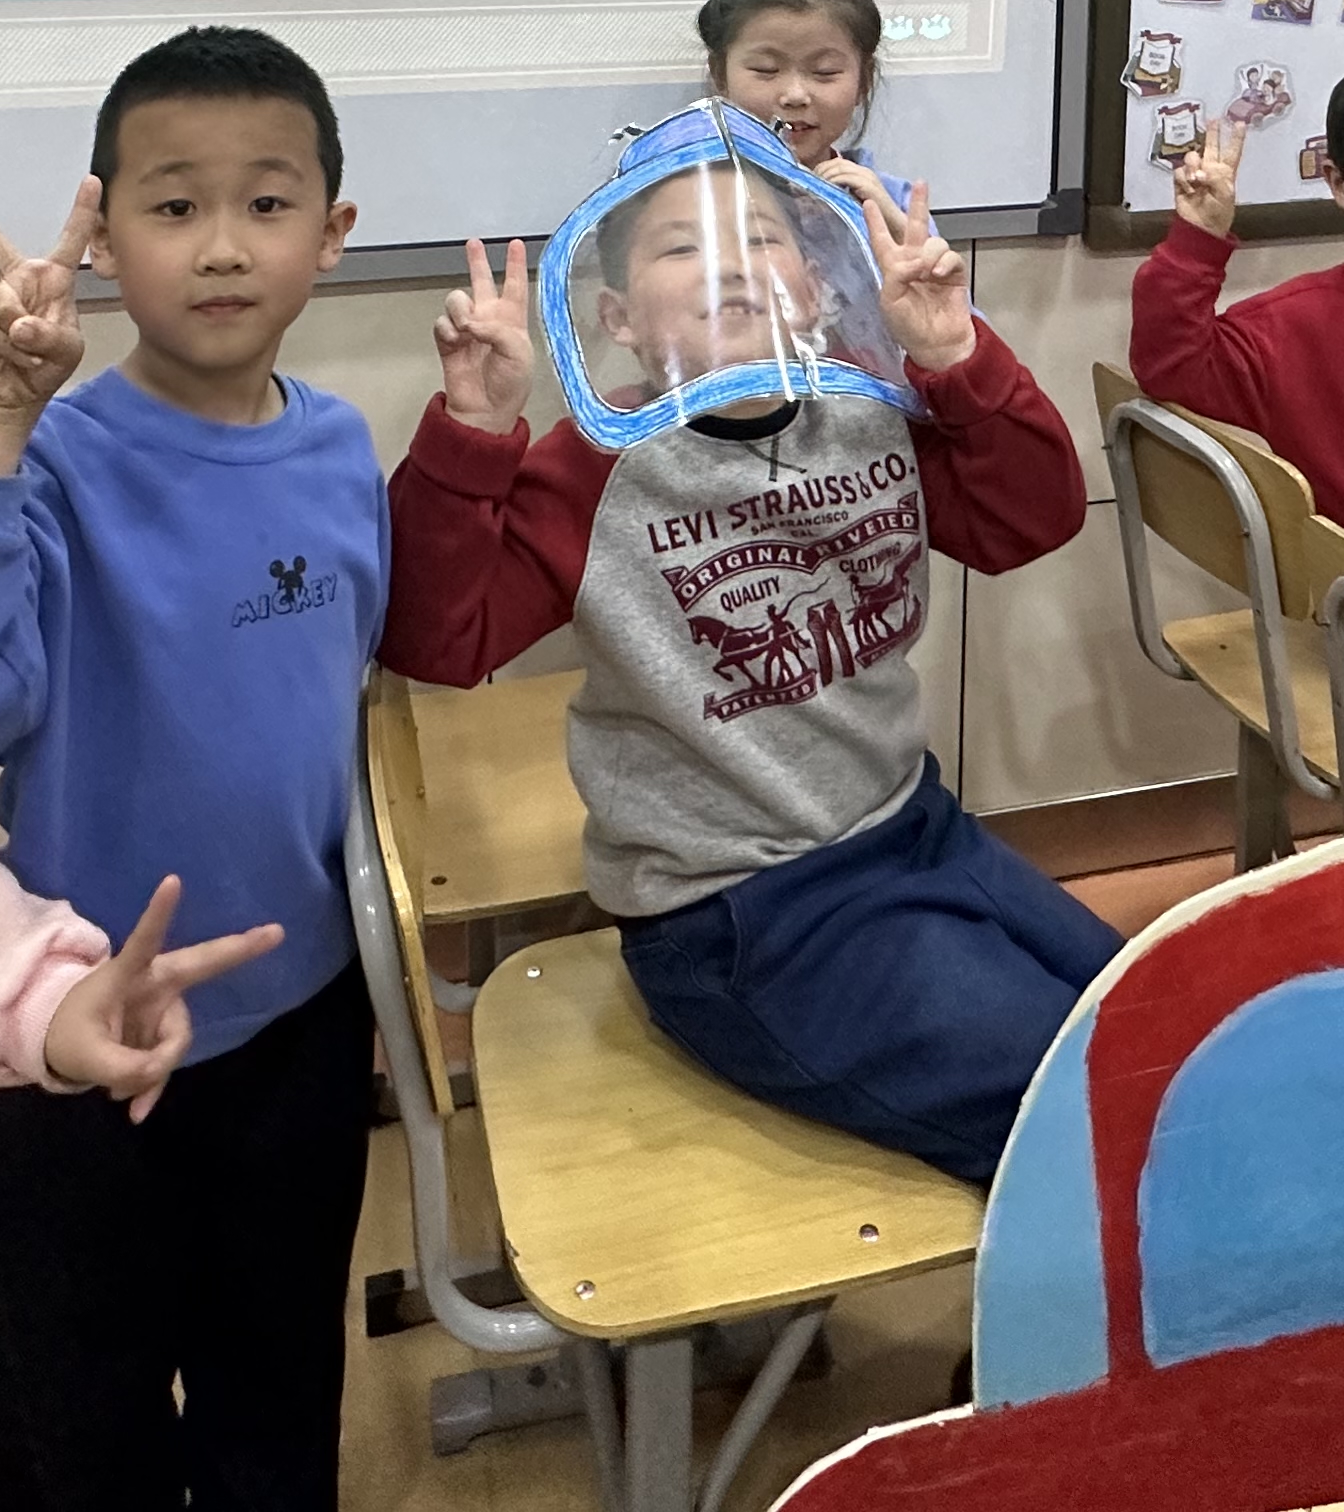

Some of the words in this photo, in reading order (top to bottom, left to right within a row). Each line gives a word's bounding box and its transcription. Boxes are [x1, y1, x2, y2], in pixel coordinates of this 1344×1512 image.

[647, 510, 718, 554] LEVI
[779, 510, 849, 528] FRANCISCO
[682, 545, 807, 600] ORIGINAL
[816, 512, 915, 559] RIVETED
[232, 572, 337, 628] MICKEY
[720, 575, 781, 612] QUALITY
[722, 683, 811, 716] PATENTED
